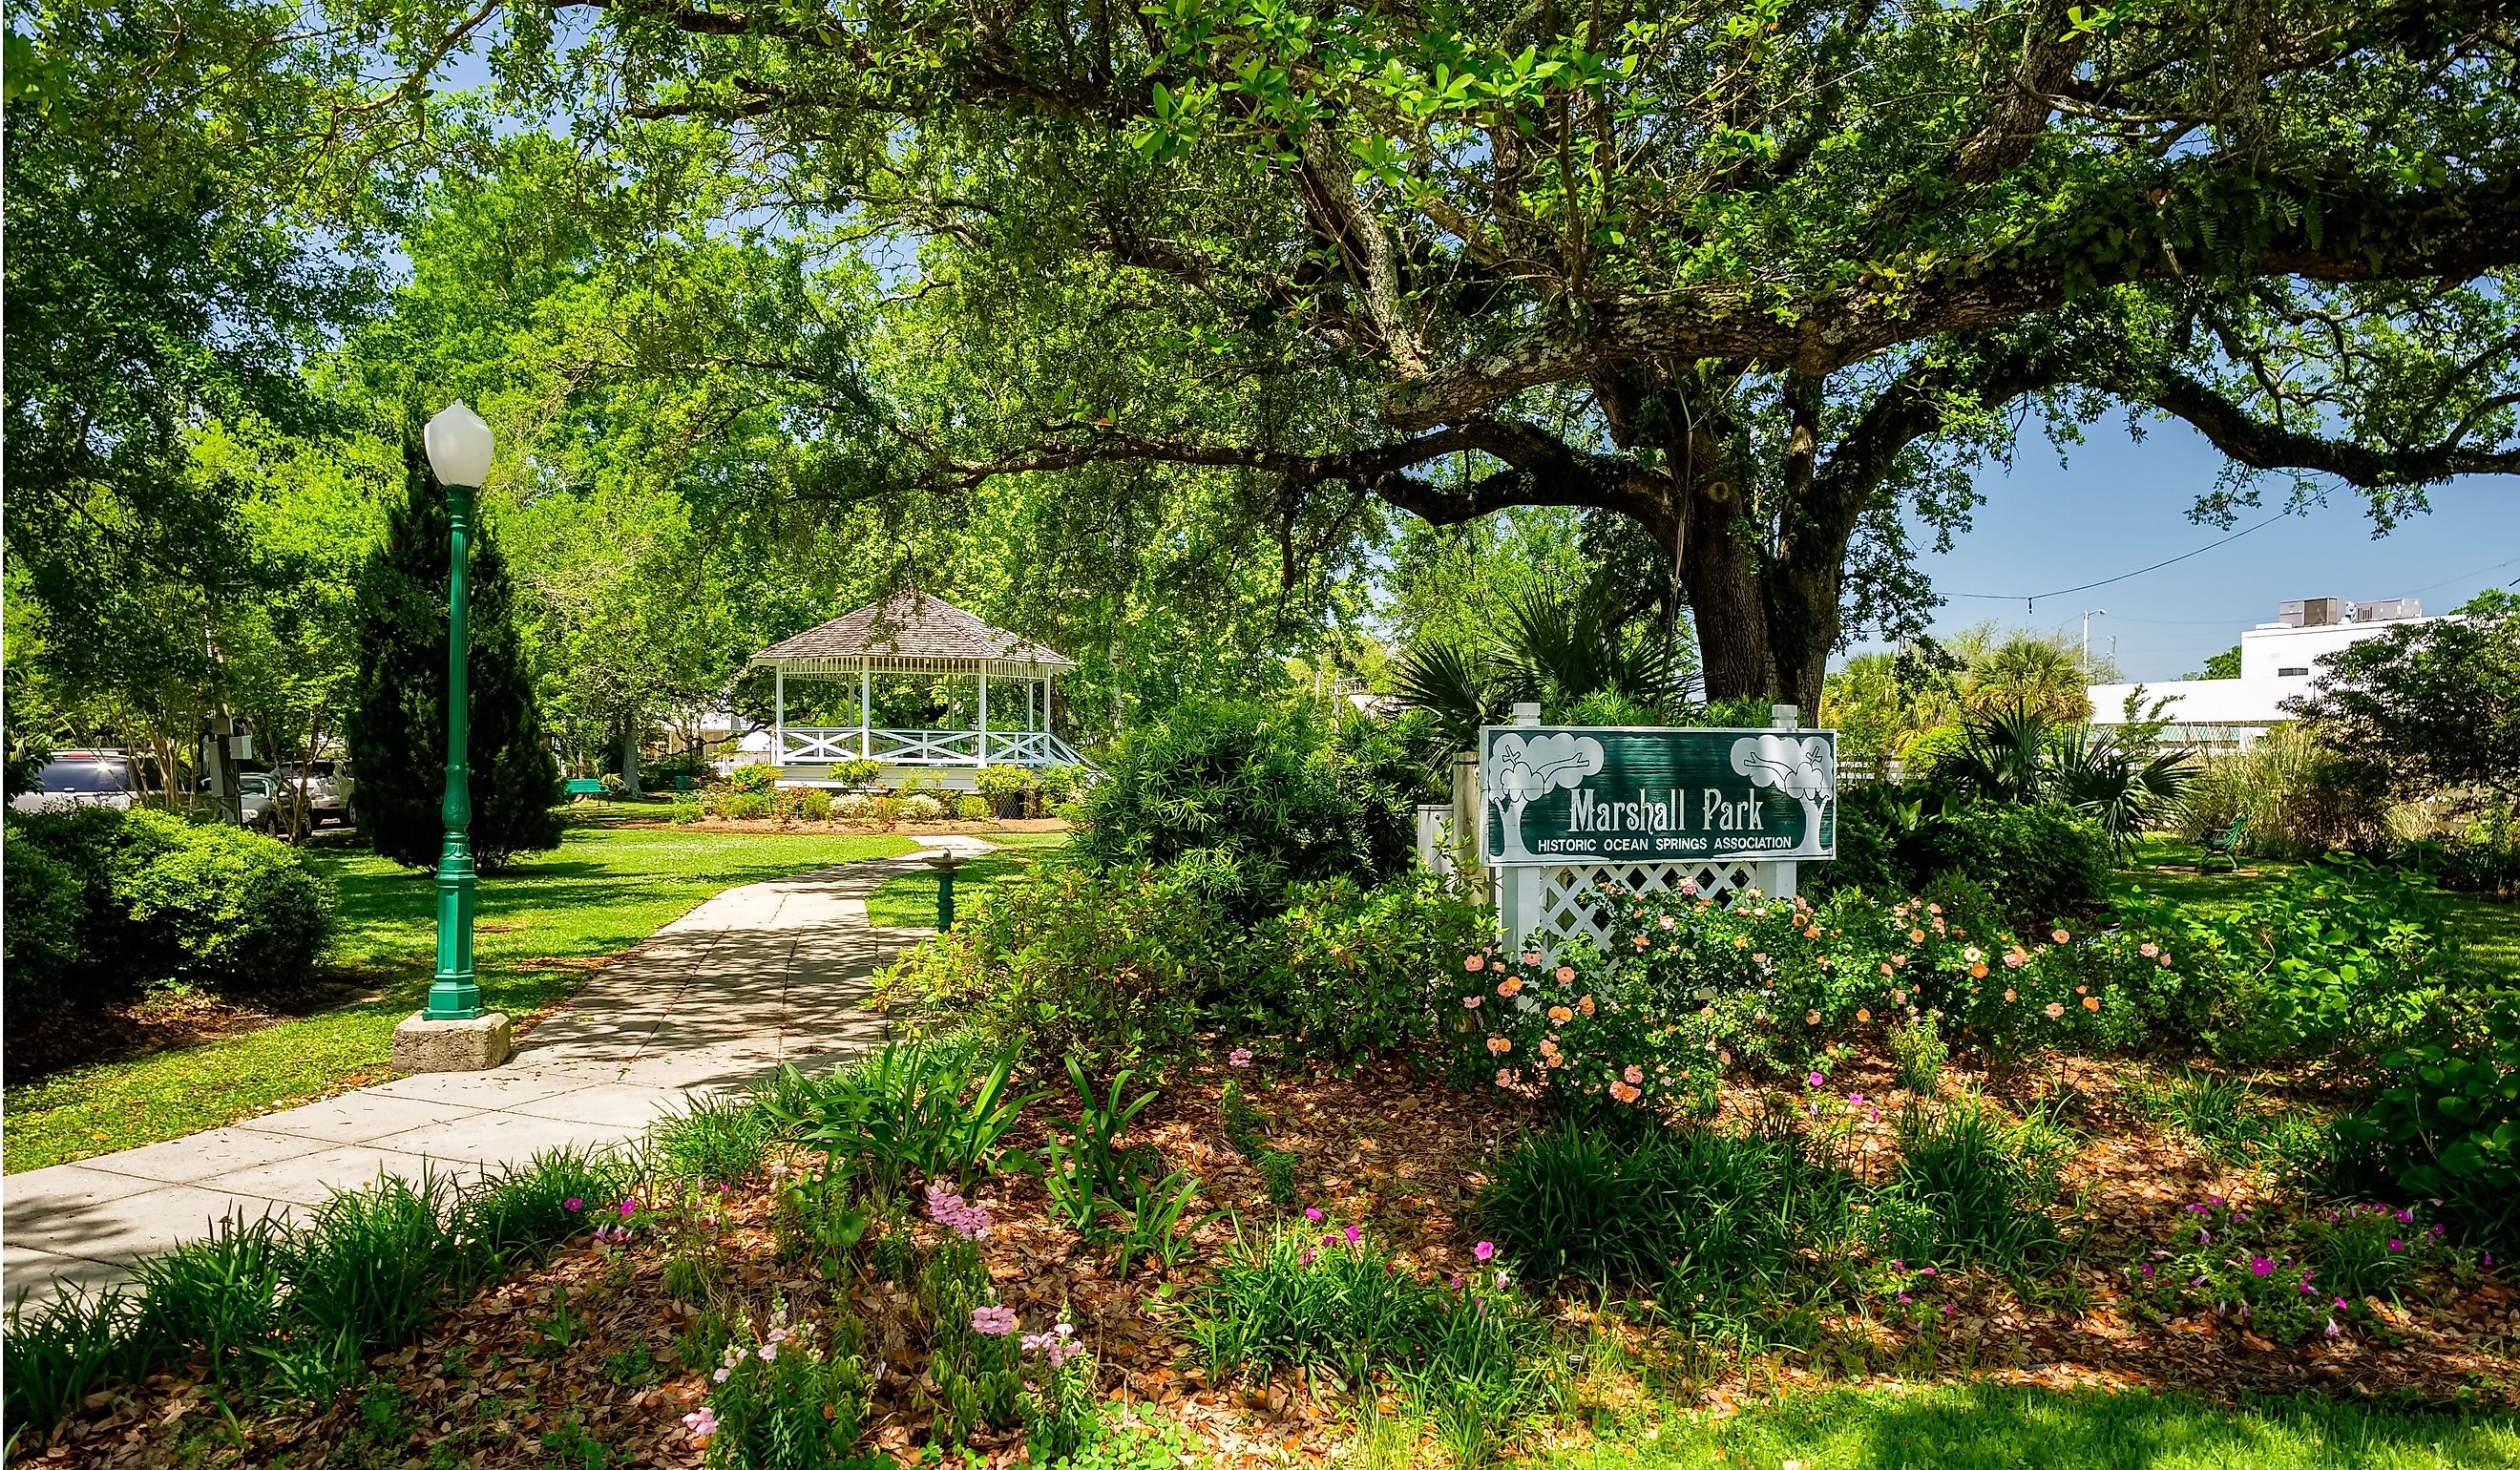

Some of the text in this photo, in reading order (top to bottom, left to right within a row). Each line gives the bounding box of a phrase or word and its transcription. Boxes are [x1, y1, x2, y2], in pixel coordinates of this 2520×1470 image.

[1567, 788, 1764, 835] Marshall Park
[1538, 836, 1792, 851] HISTORIC OCEAN SPRINGS ASSOCIATION
